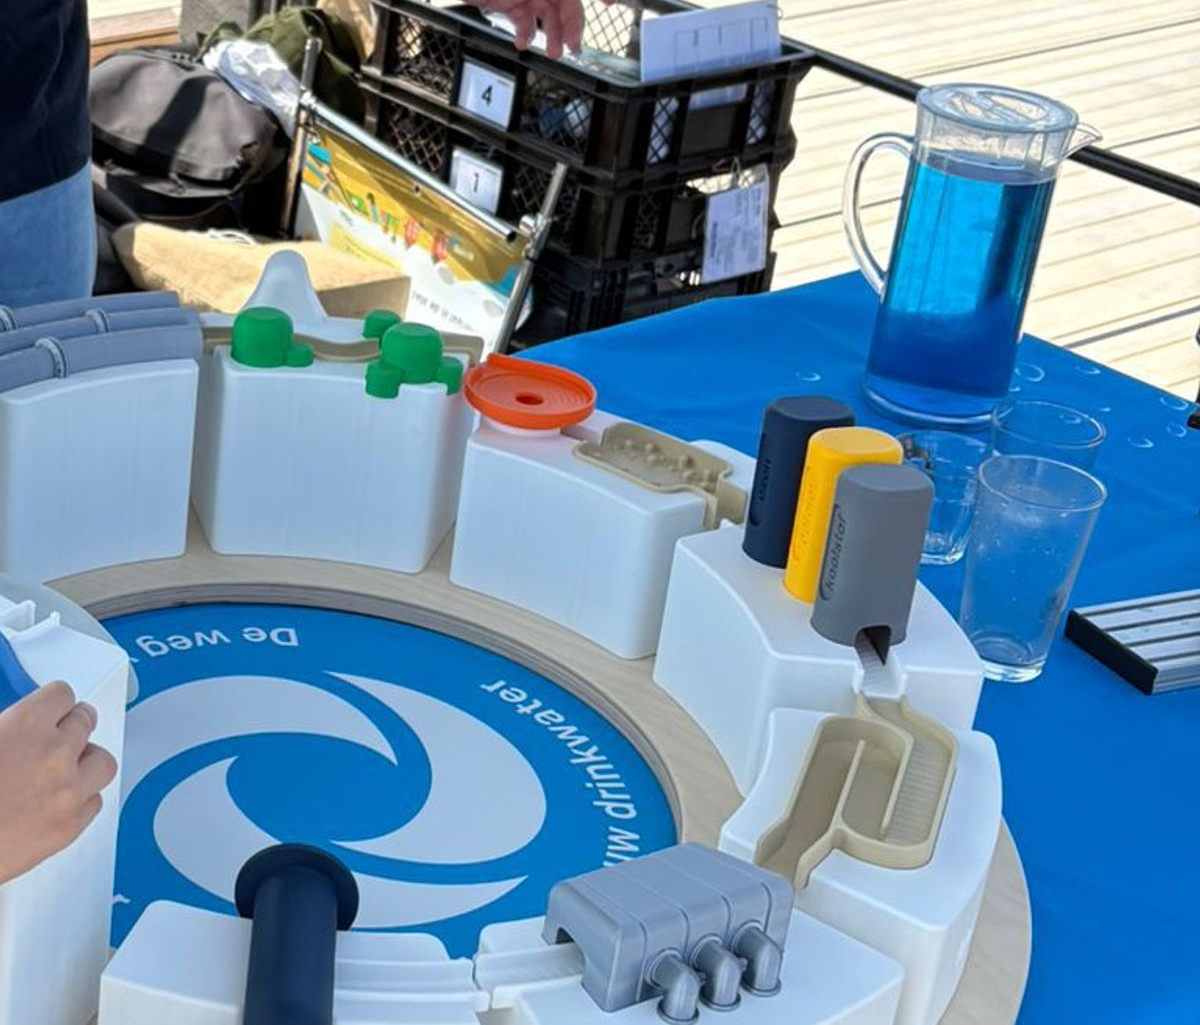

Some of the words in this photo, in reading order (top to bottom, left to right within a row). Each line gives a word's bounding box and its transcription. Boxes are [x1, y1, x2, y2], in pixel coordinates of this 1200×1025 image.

[481, 84, 493, 107] 4
[825, 512, 848, 592] koolstof
[135, 629, 231, 657] weg
[242, 627, 299, 647] De
[479, 680, 637, 819] drinkwater
